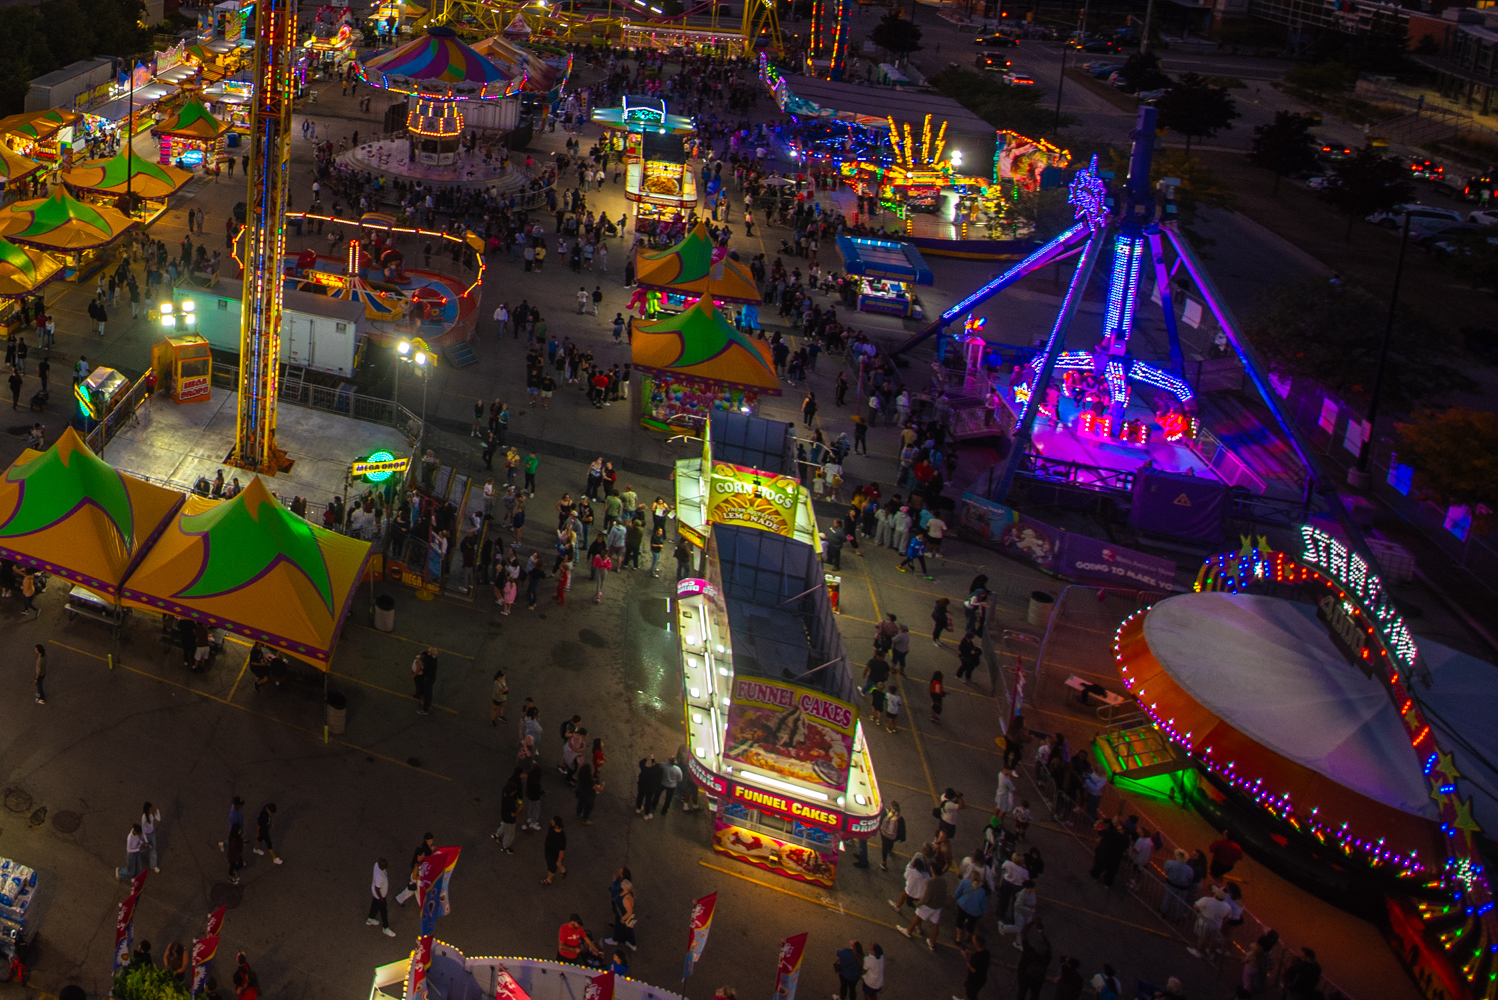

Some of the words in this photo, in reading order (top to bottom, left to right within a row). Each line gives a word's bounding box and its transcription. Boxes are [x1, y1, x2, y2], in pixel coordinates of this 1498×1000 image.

[356, 465, 380, 473] MEGA
[382, 461, 406, 470] DROP
[715, 481, 753, 496] CORN
[1075, 560, 1110, 573] GOING
[1111, 566, 1125, 577] TO
[1126, 569, 1156, 587] MAKE
[1158, 581, 1175, 592] YO
[1321, 595, 1366, 657] 4000
[736, 680, 799, 708] FUNNEL
[800, 694, 853, 729] CAKES
[735, 786, 789, 811] FUNNEL
[791, 804, 839, 826] CAKES
